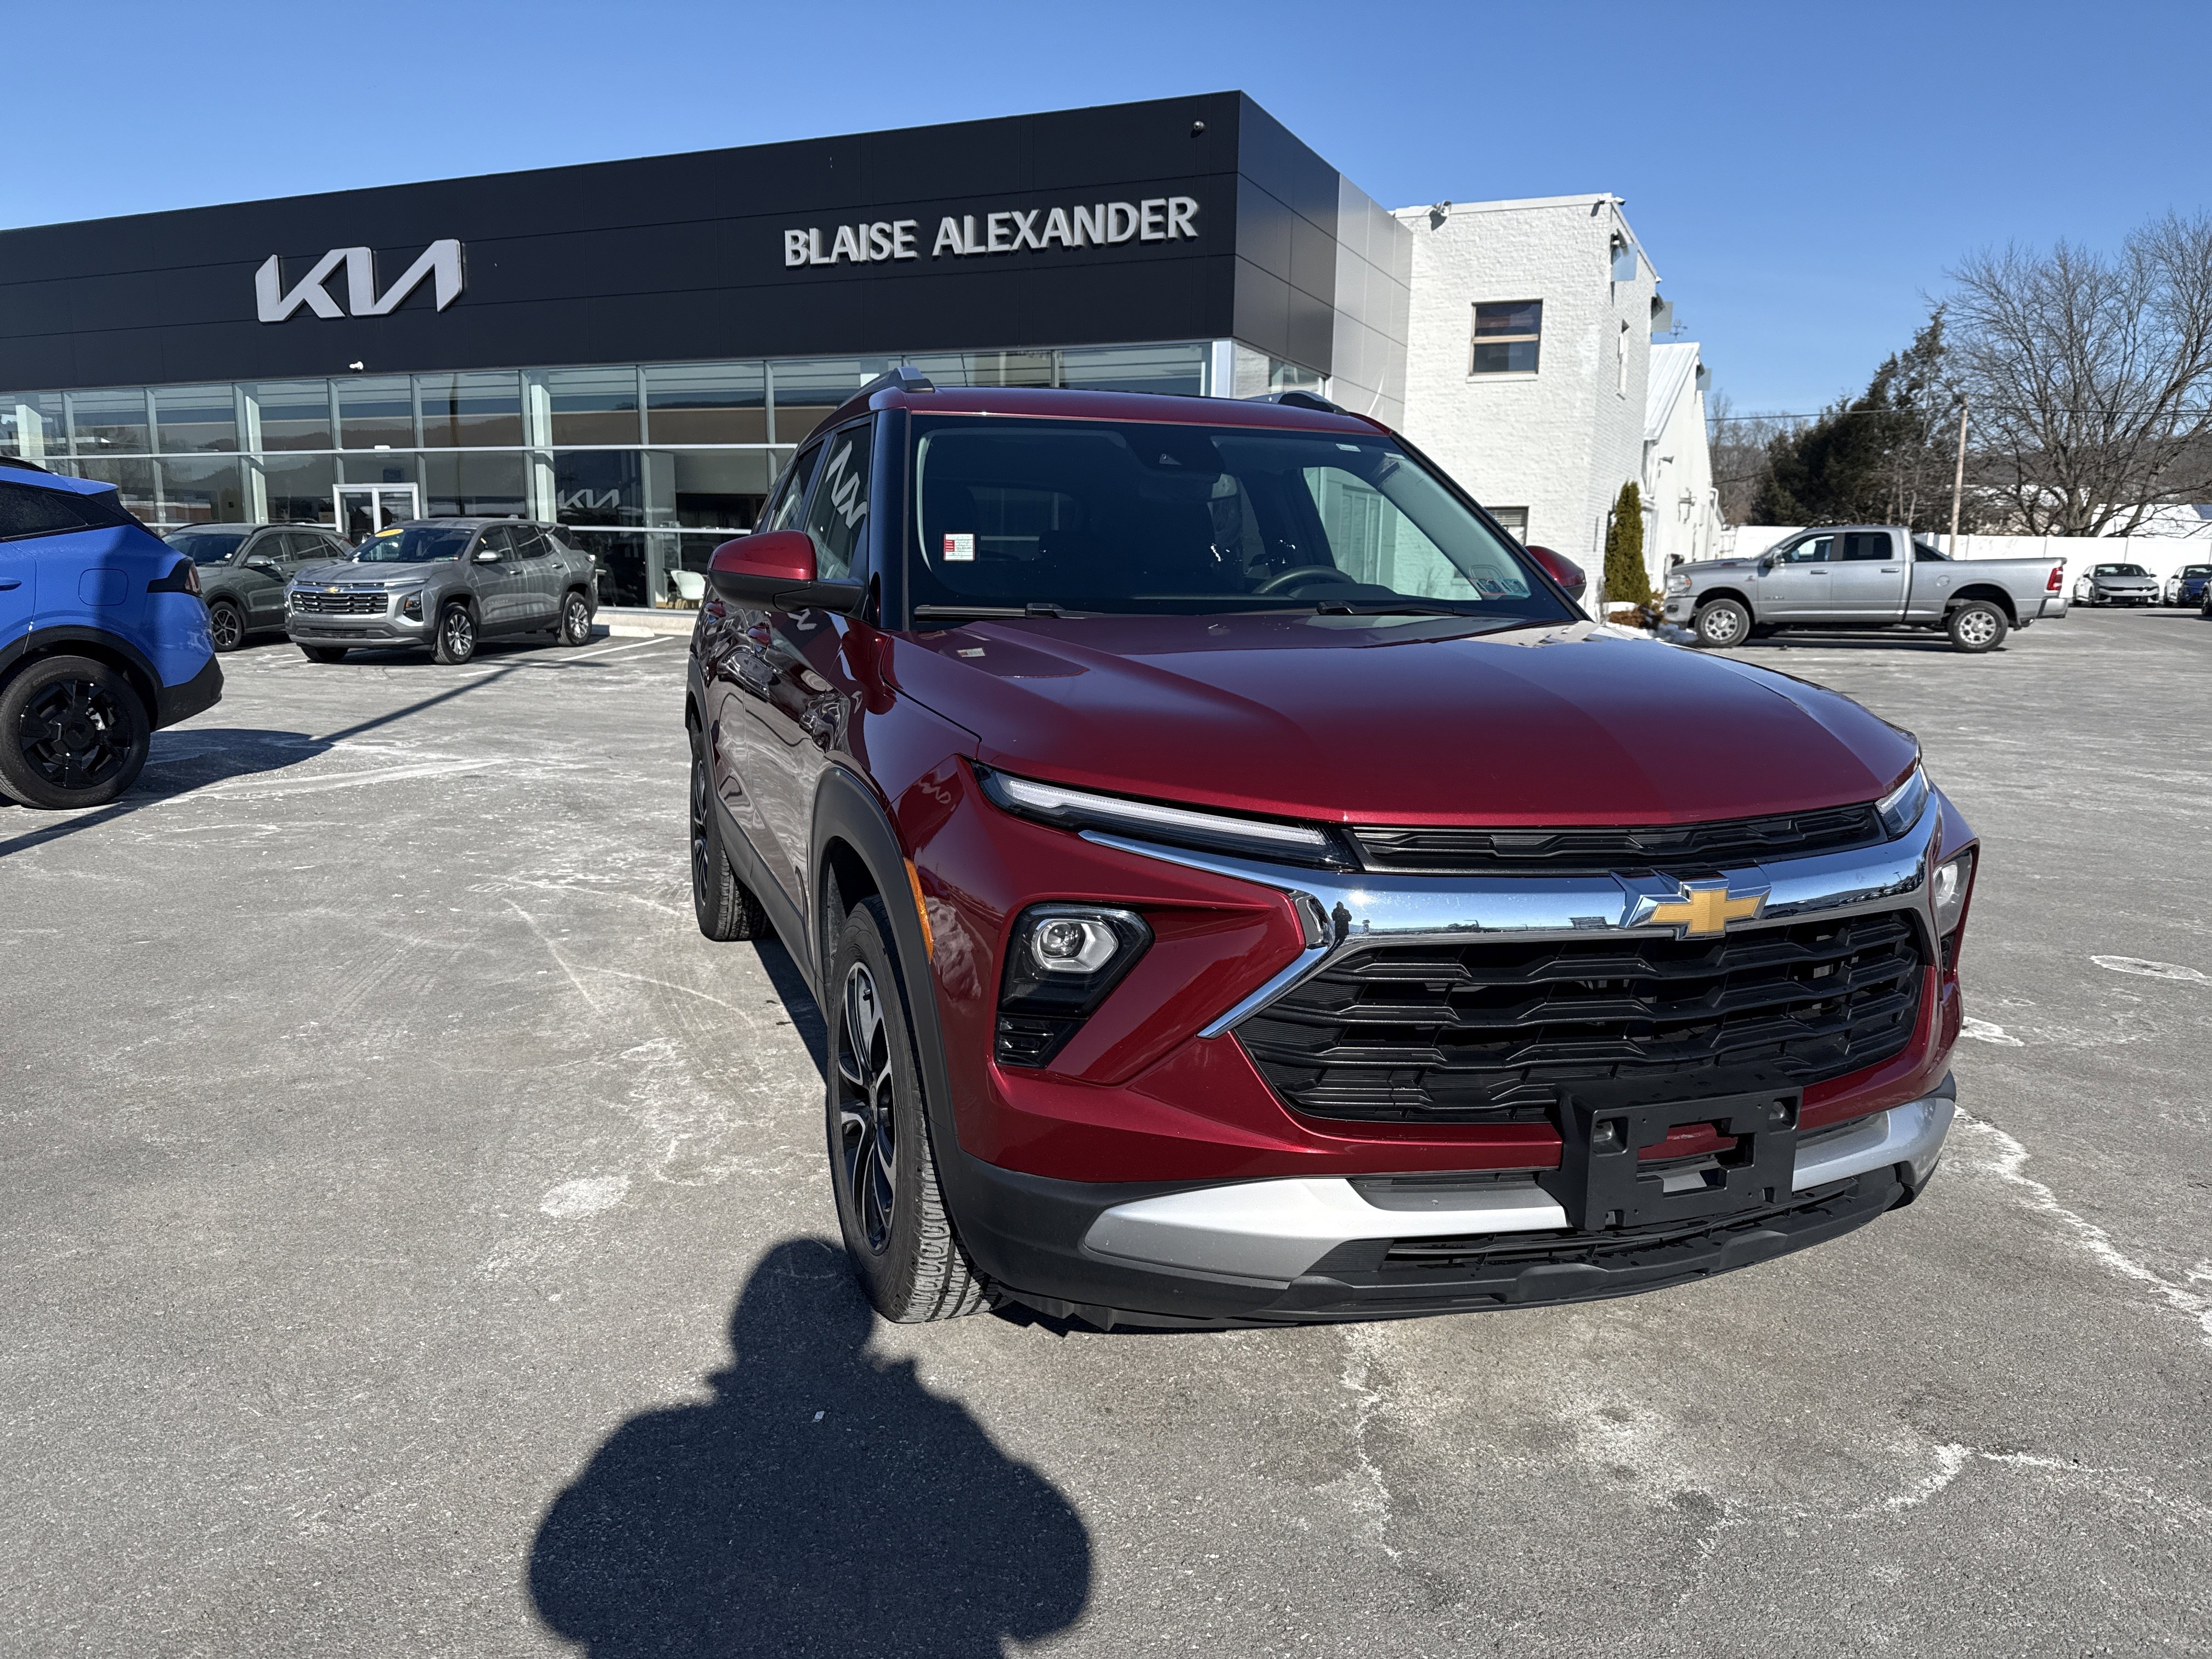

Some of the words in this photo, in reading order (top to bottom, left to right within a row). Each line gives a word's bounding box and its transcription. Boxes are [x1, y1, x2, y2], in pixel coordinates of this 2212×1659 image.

[784, 219, 919, 267] BLAISE
[932, 196, 1200, 256] ALEXANDER
[255, 238, 462, 323] KIA
